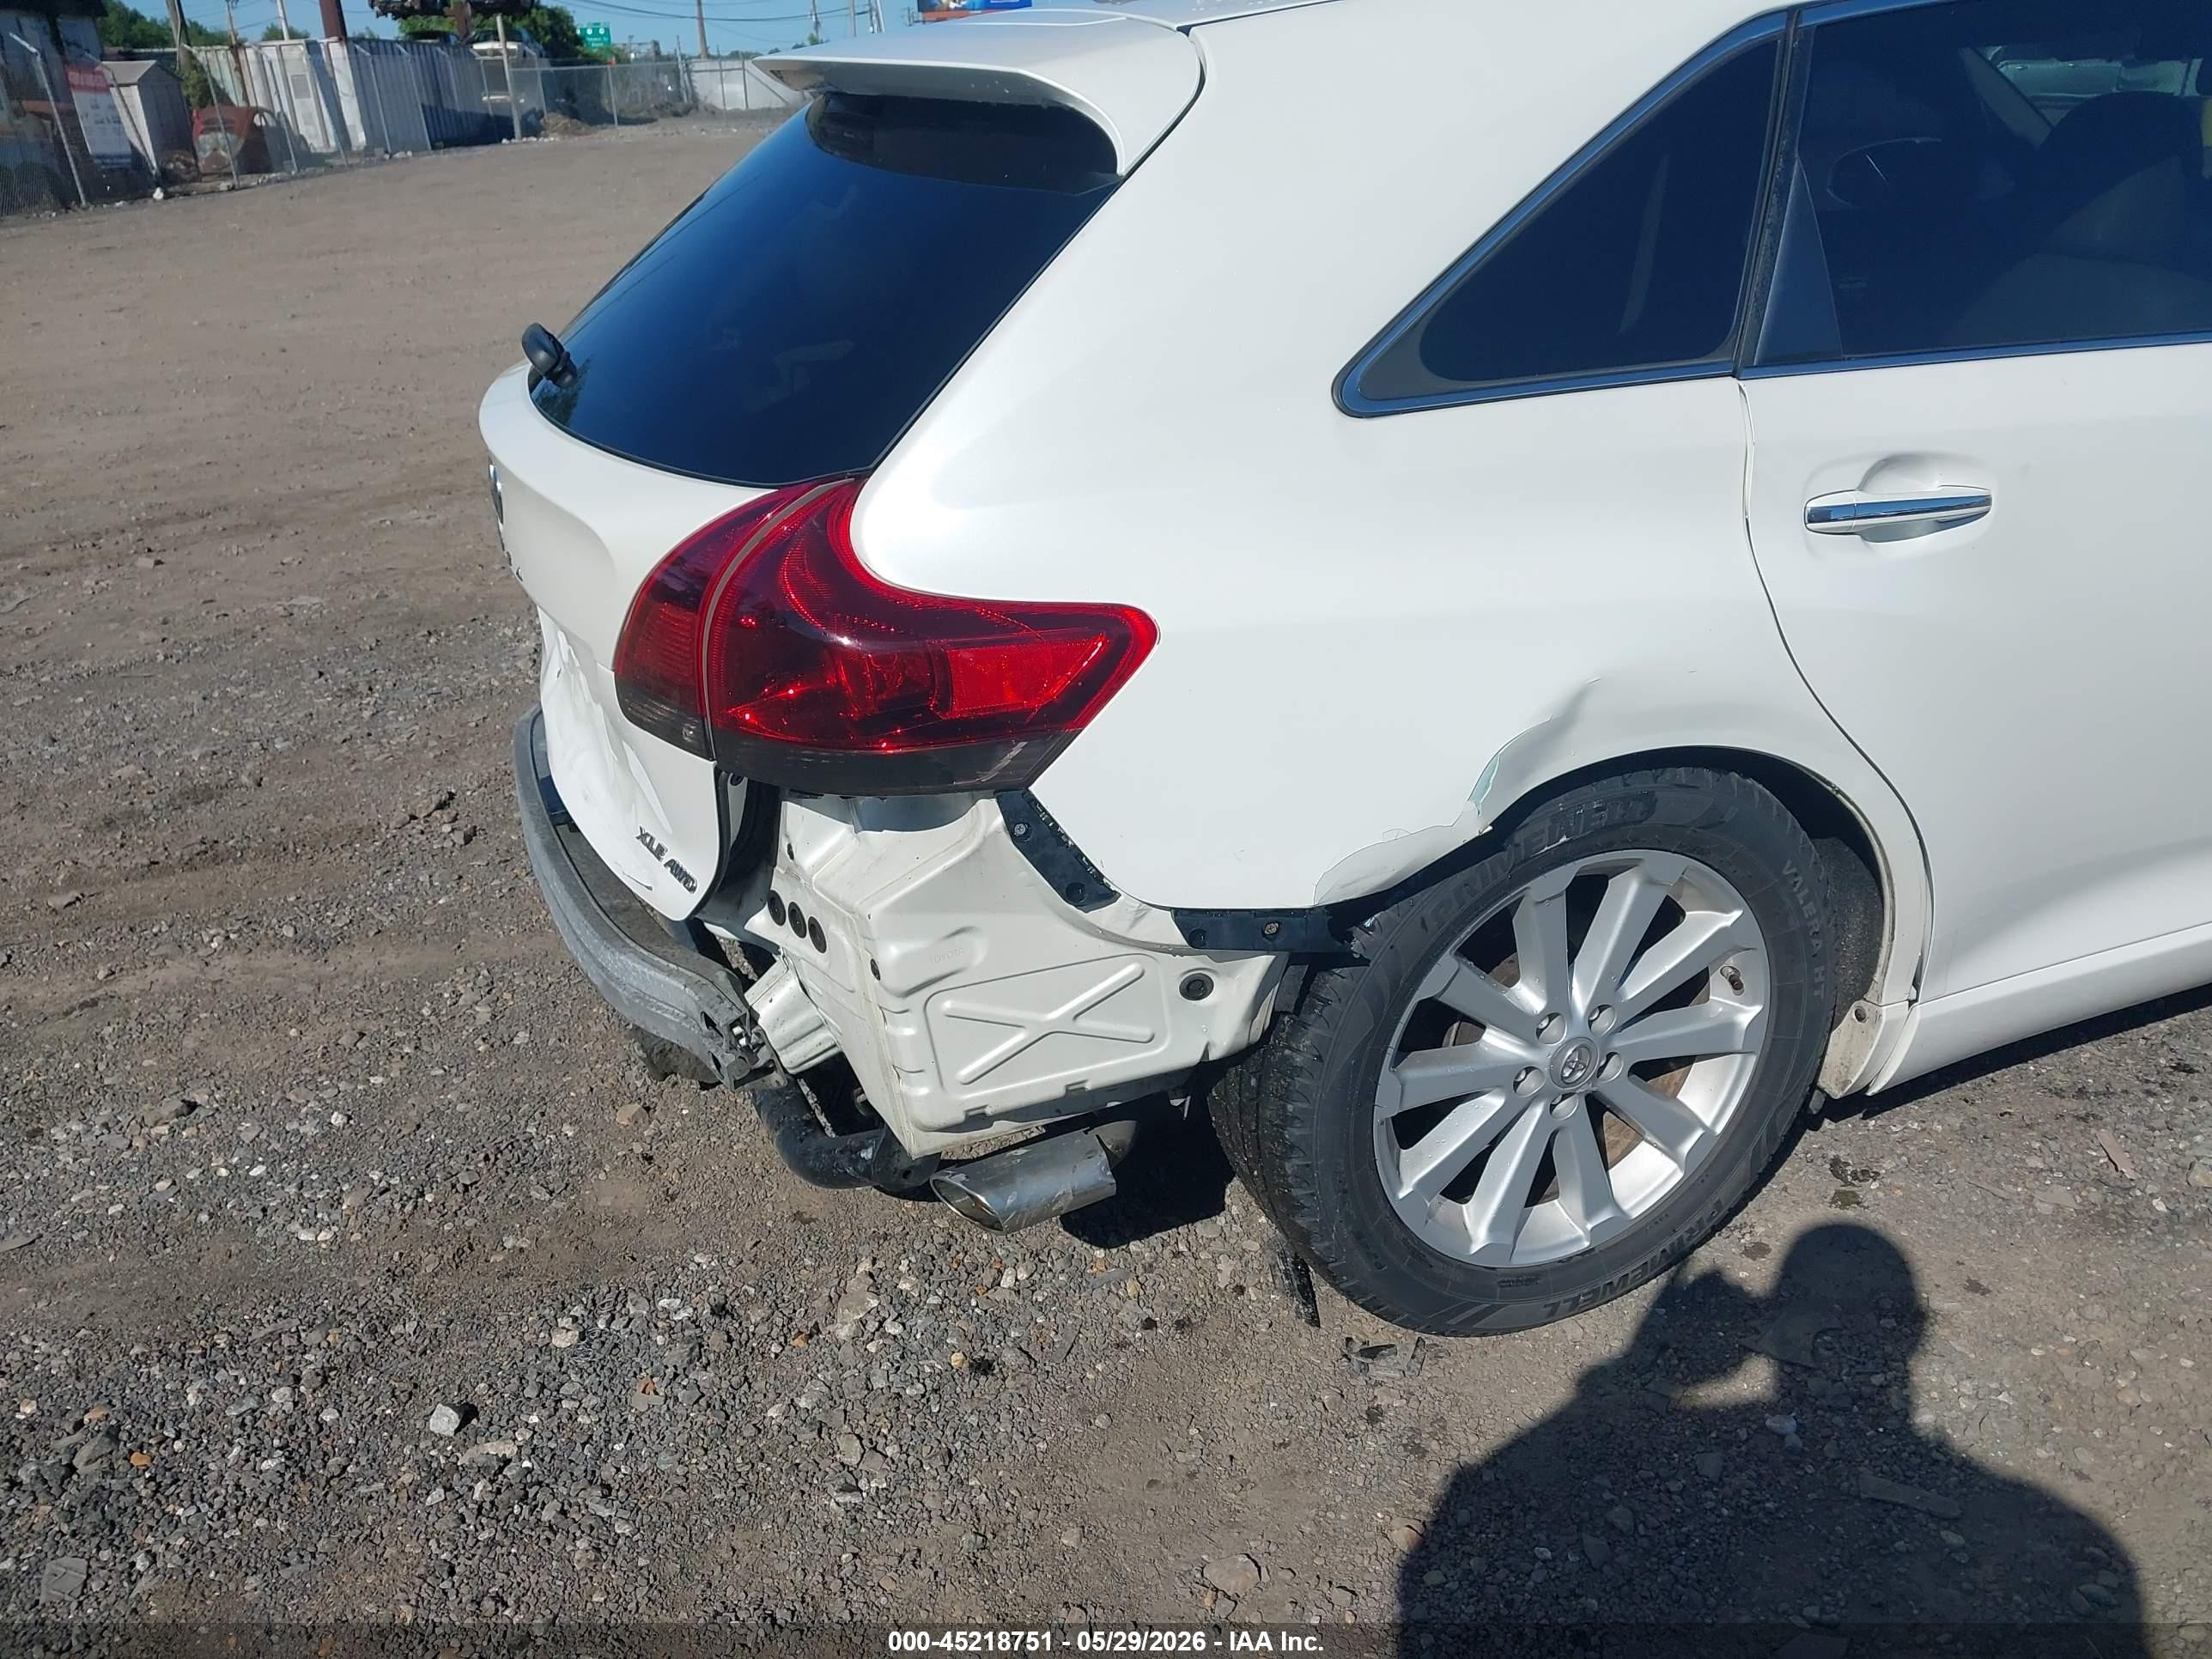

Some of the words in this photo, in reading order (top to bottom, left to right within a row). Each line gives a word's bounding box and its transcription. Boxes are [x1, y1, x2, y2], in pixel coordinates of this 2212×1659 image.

[635, 825, 669, 862] XLE
[663, 858, 699, 895] AWD
[1783, 859, 1822, 957] VALERA
[1814, 964, 1825, 999] HT
